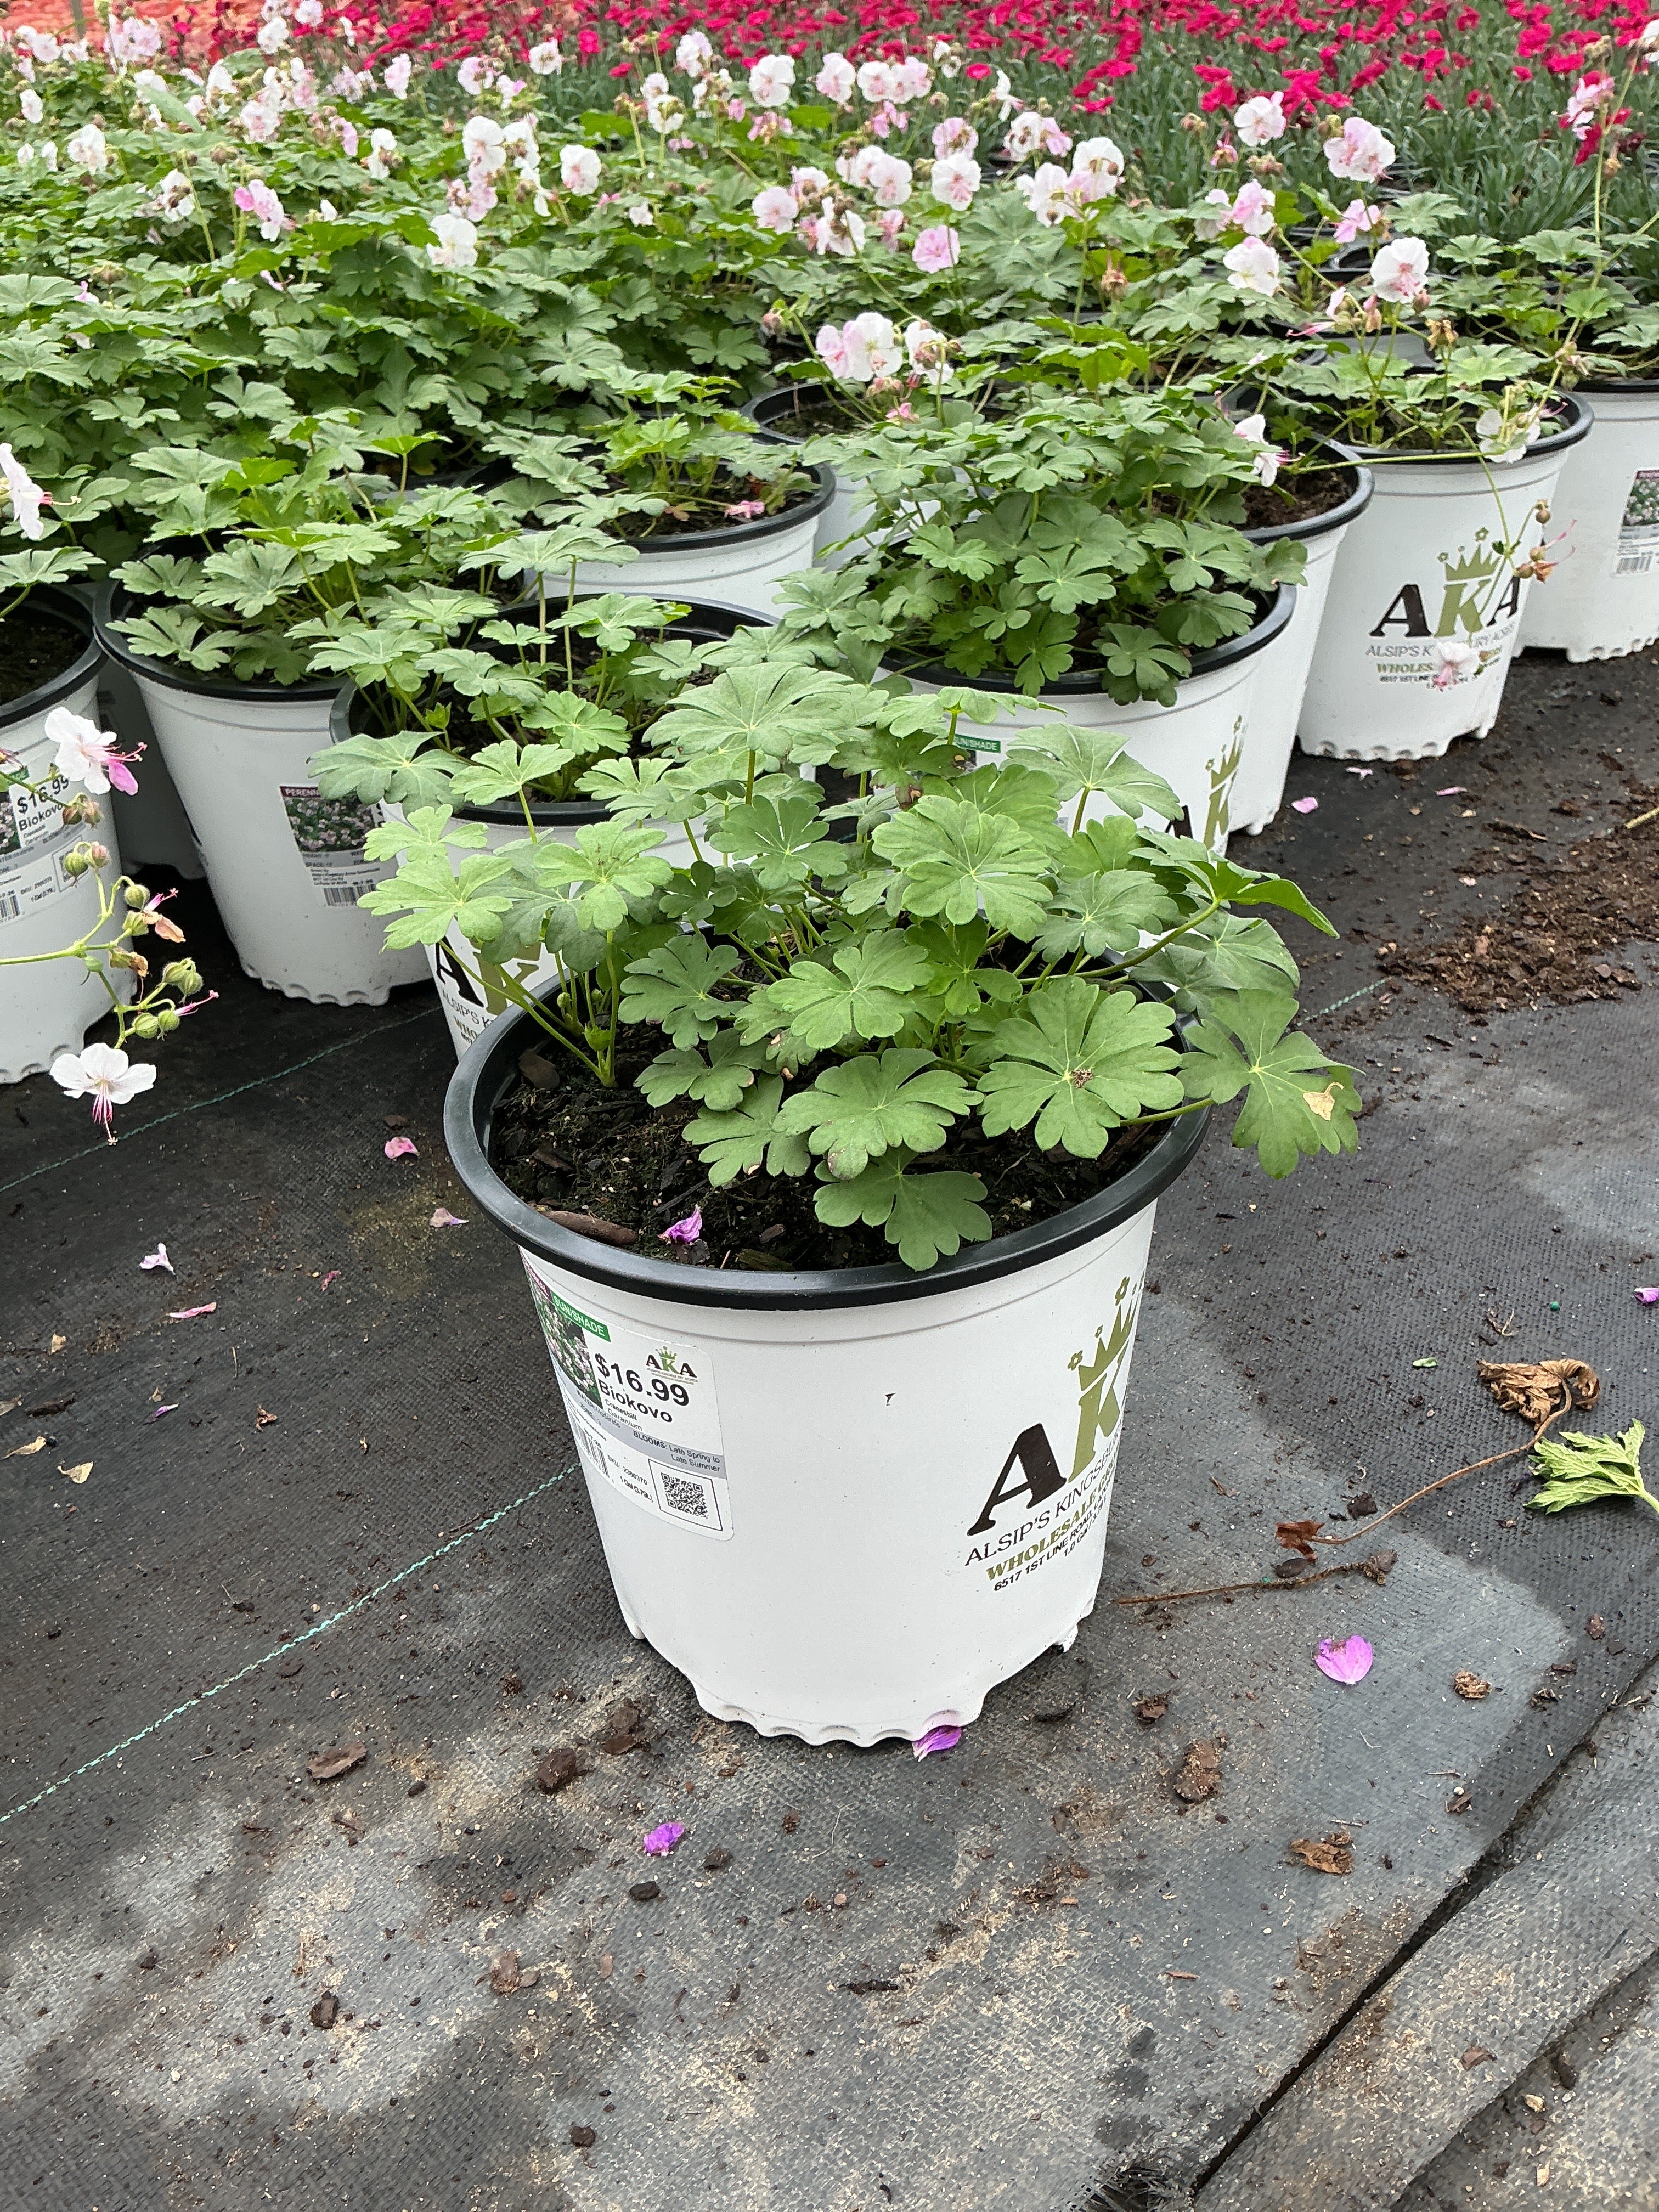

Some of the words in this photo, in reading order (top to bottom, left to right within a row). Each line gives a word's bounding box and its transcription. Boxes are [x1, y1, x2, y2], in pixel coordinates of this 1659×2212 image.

[1369, 575, 1521, 638] AKA
[1376, 662, 1434, 673] WHOLES
[18, 804, 64, 832] Biokovo
[553, 1295, 606, 1338] SUN/SHADE
[595, 1353, 689, 1406] $16.99
[646, 1353, 698, 1378] AKA
[598, 1378, 673, 1423] Biokovo
[605, 1398, 637, 1421] Cranesbill
[607, 1408, 643, 1432] Geranium
[633, 1430, 668, 1449] BLOOMS:
[669, 1444, 685, 1455] Late
[686, 1449, 711, 1463] Spring
[671, 1454, 687, 1464] Late
[689, 1459, 720, 1472] Summer
[964, 1510, 1051, 1567] ALSIP'S
[985, 1486, 1097, 1581] WHOLESALE
[1064, 1540, 1076, 1557] 1.0
[994, 1570, 1022, 1591] 6517
[1025, 1554, 1046, 1574] 1ST
[1046, 1534, 1069, 1561] LINE
